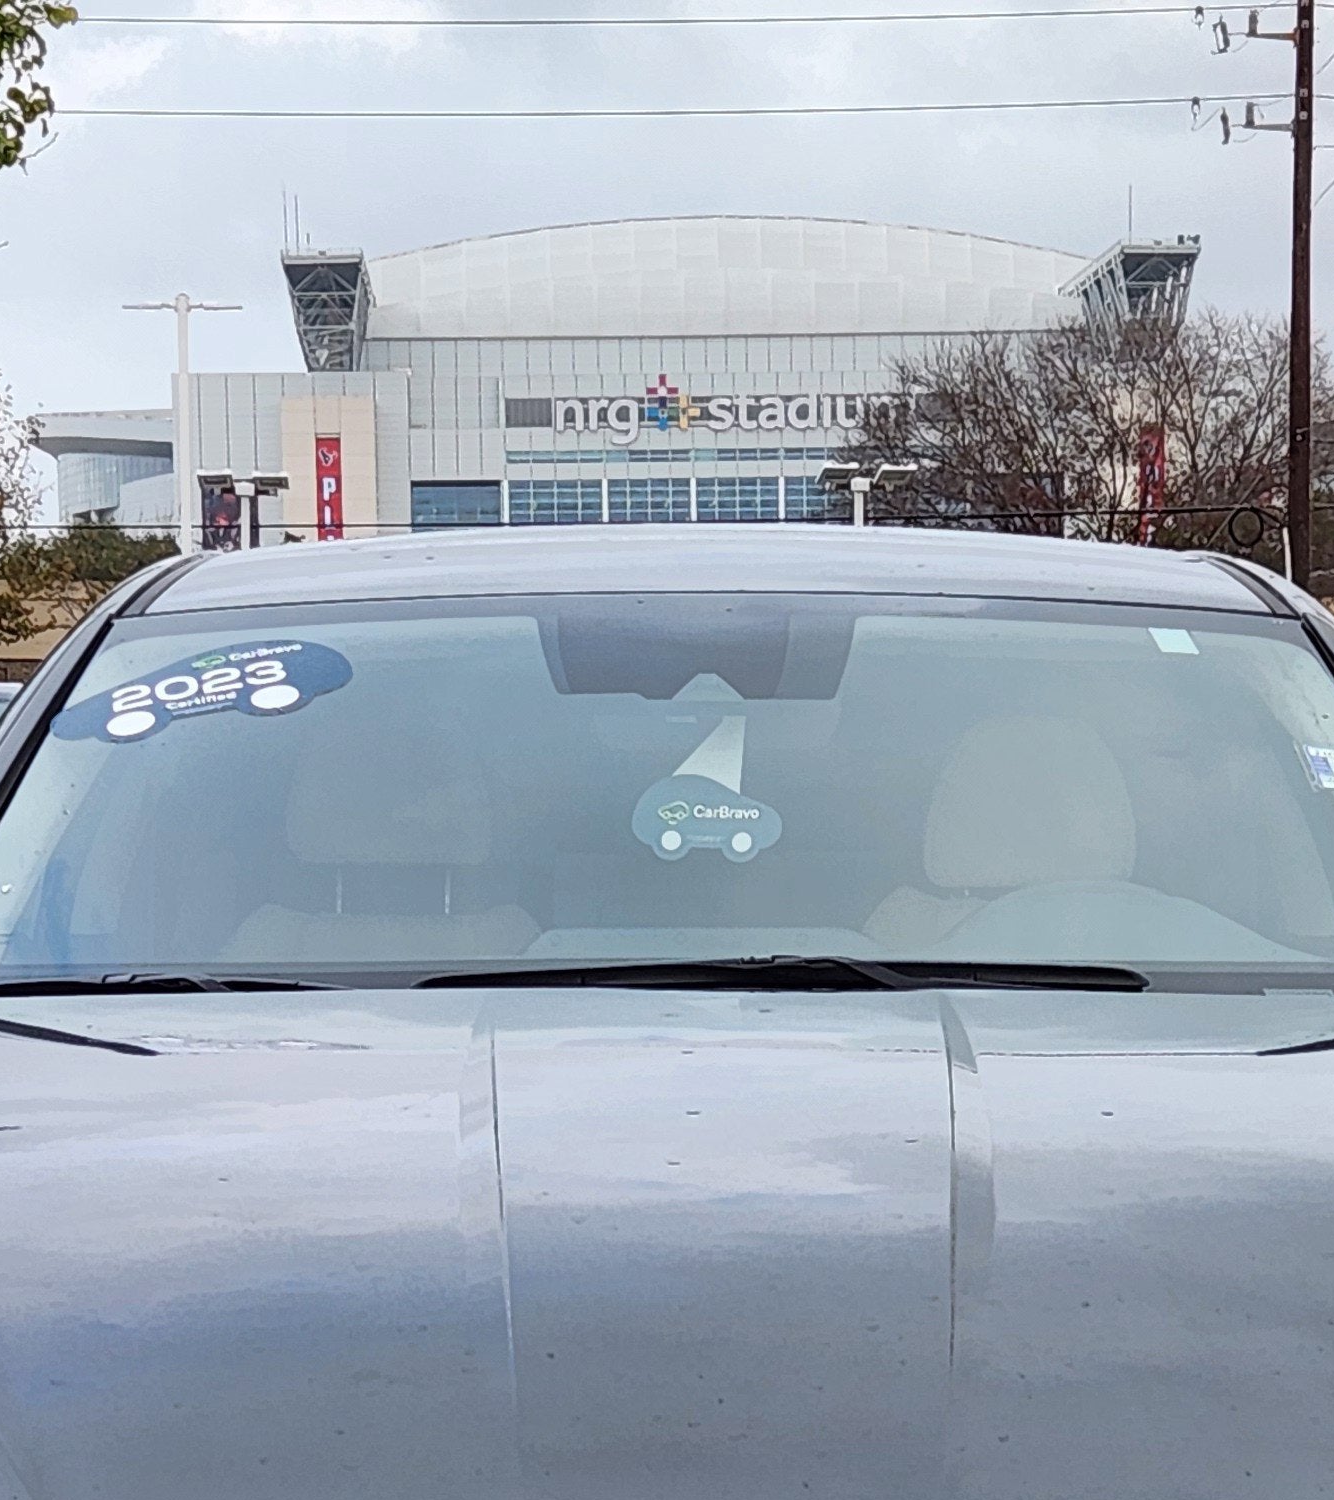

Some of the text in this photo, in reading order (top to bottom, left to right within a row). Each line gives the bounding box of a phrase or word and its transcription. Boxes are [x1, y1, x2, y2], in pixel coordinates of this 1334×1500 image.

[554, 396, 640, 444] nrg
[111, 659, 287, 713] 2023
[692, 803, 760, 820] CarBravo
